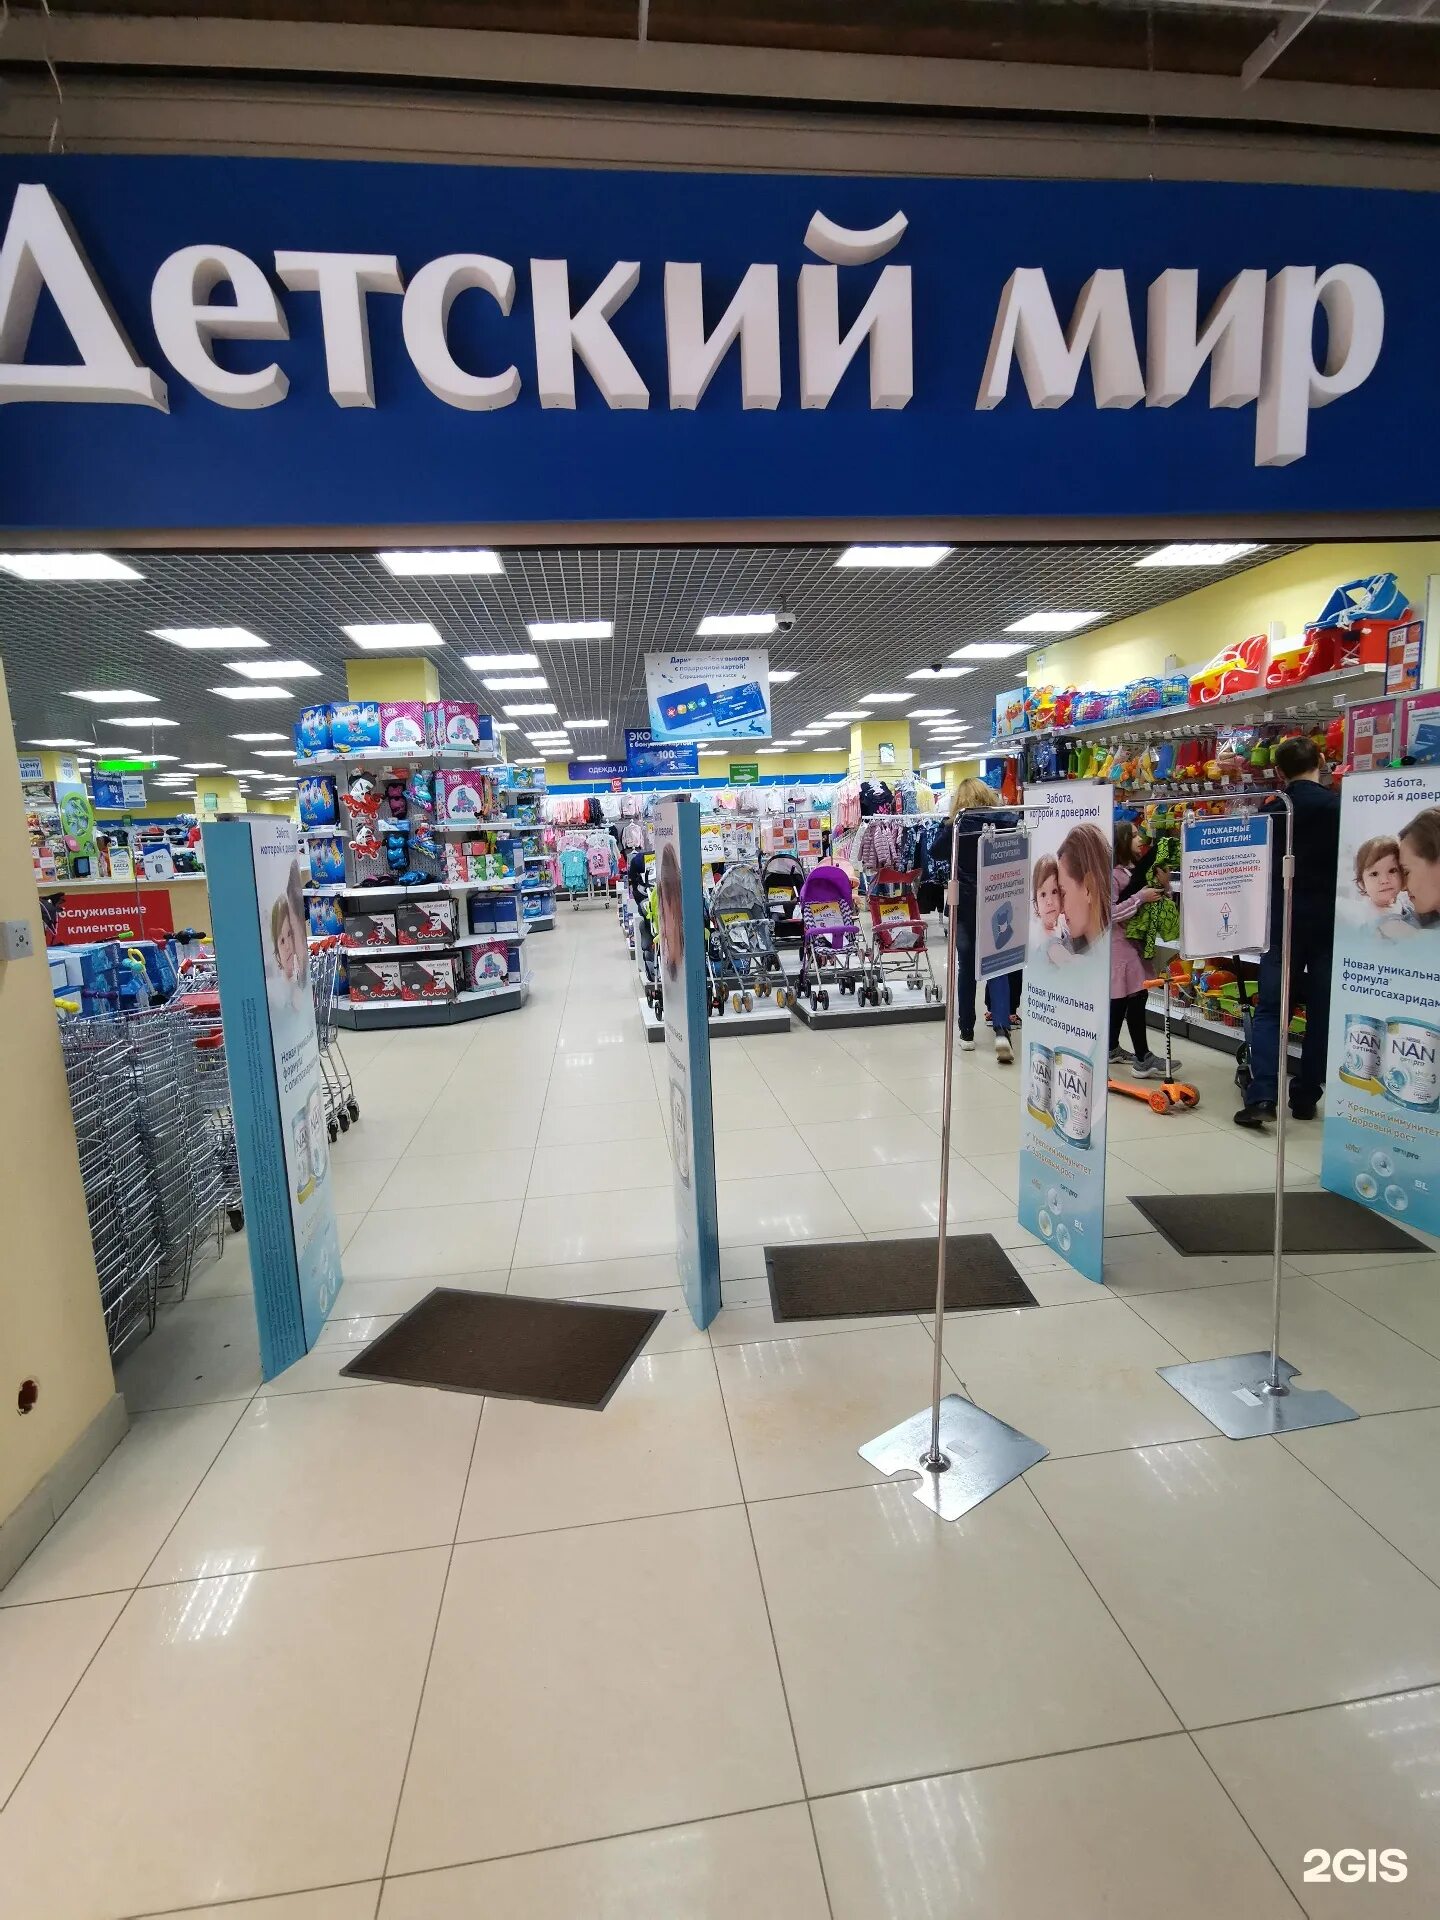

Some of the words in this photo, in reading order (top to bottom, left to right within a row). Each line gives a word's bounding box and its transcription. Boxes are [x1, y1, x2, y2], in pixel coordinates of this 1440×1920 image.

[0, 183, 913, 415] Детский
[975, 263, 1385, 467] мир
[629, 732, 650, 741] ЭКО
[1384, 777, 1426, 788] Забота,
[1046, 793, 1074, 804] Забота,
[1352, 791, 1394, 804] которой
[1406, 791, 1440, 802] довер
[1061, 806, 1100, 820] доверяю!
[1202, 824, 1250, 836] УВАЖАЕМЫЕ
[1200, 834, 1252, 846] ПОСЕТИТЕЛИ!
[1188, 866, 1260, 878] ДИСТАНЦИРОВАНИЯ:
[58, 904, 147, 920] бслуживание
[67, 924, 130, 935] клиентов
[1342, 970, 1389, 986] формула
[1343, 958, 1375, 971] Новая
[1378, 964, 1440, 982] уникальна
[1027, 982, 1046, 998] Новая
[1047, 991, 1094, 1012] уникальная
[1342, 982, 1348, 990] с
[1350, 984, 1440, 1008] олигосахаридам
[1027, 995, 1056, 1014] формула
[1031, 1012, 1097, 1041] олигосахаридами
[1349, 1032, 1381, 1050] NAN
[1392, 1039, 1436, 1064] NAN
[1032, 1061, 1052, 1080] NAN
[1430, 1073, 1437, 1084] 3
[1058, 1070, 1088, 1098] NAN
[1347, 1113, 1392, 1136] Здоровый
[1394, 1131, 1417, 1143] рост
[1348, 1101, 1386, 1121] Крепкий
[1387, 1114, 1440, 1138] иммунитет
